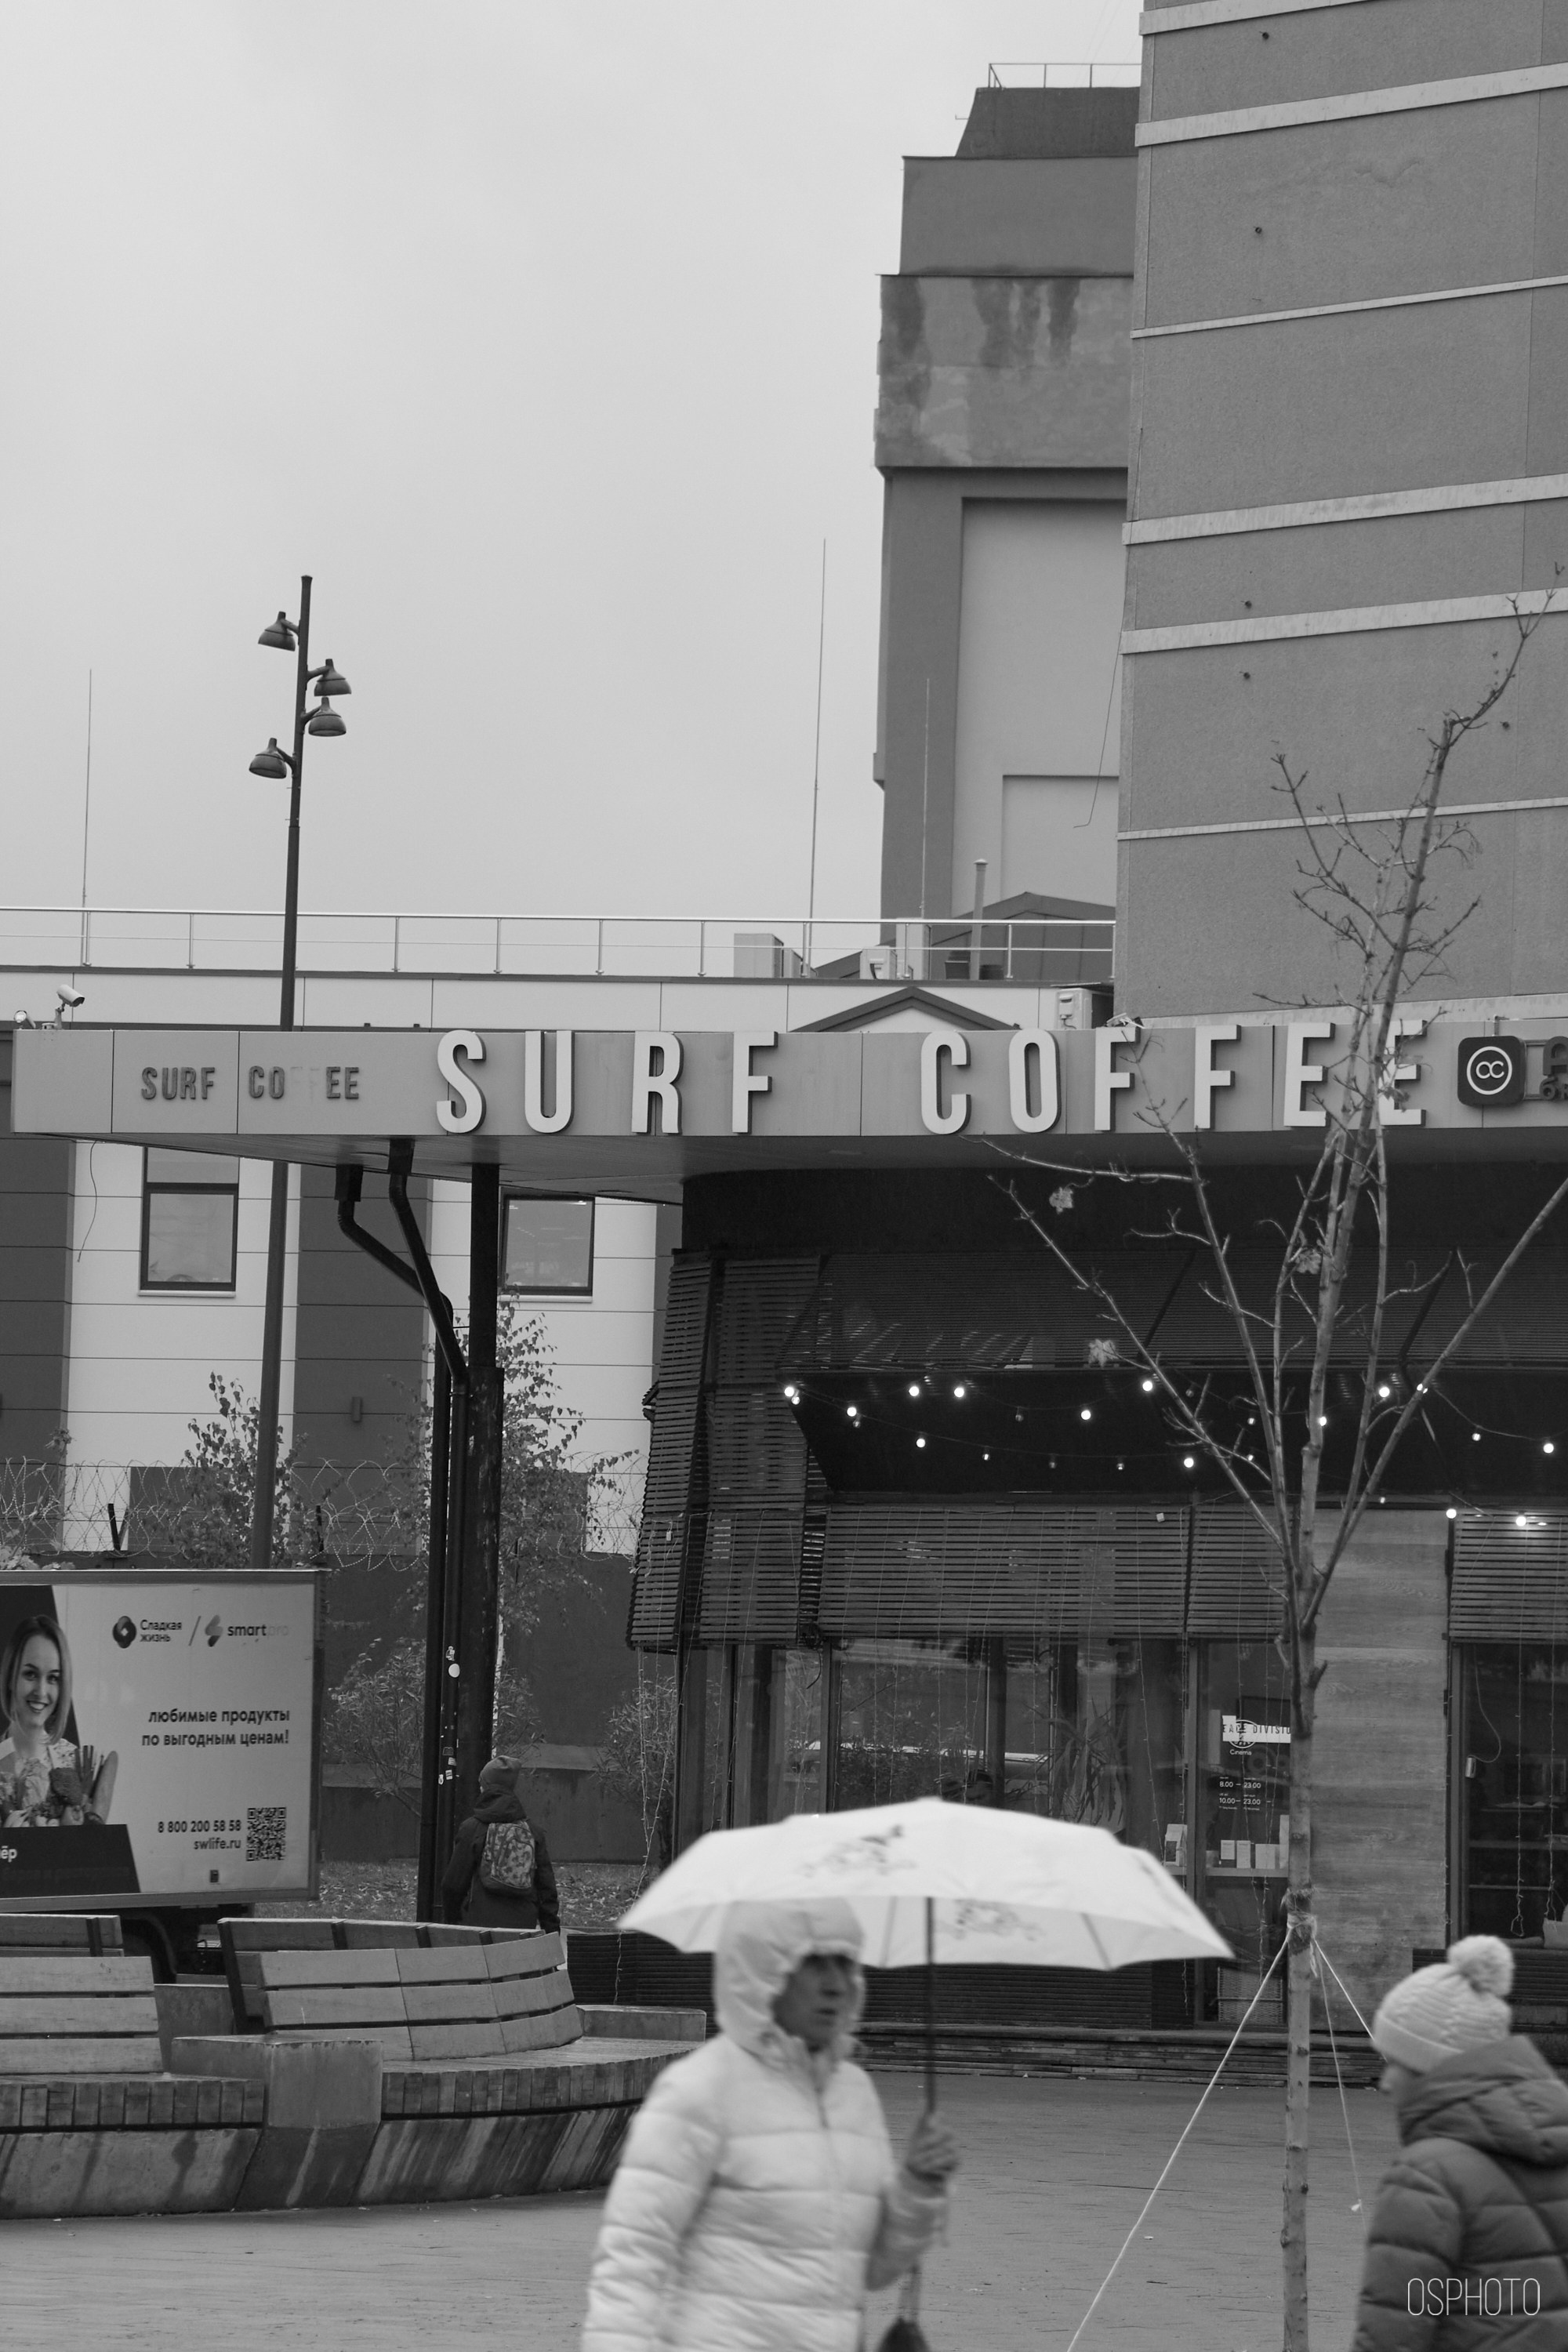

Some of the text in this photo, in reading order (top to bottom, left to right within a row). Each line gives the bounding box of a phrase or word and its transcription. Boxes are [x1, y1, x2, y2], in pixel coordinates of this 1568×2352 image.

[141, 1066, 216, 1099] SURF
[436, 1020, 1427, 1135] SURF COFFEE
[140, 1619, 182, 1632] Сладкая
[140, 1633, 171, 1642] жизнь
[148, 1708, 290, 1726] любимые продукты
[141, 1730, 289, 1748] по выгодным ценам!
[158, 1820, 241, 1833] 8 800 200 58 58
[194, 1837, 241, 1849] swlife.ru
